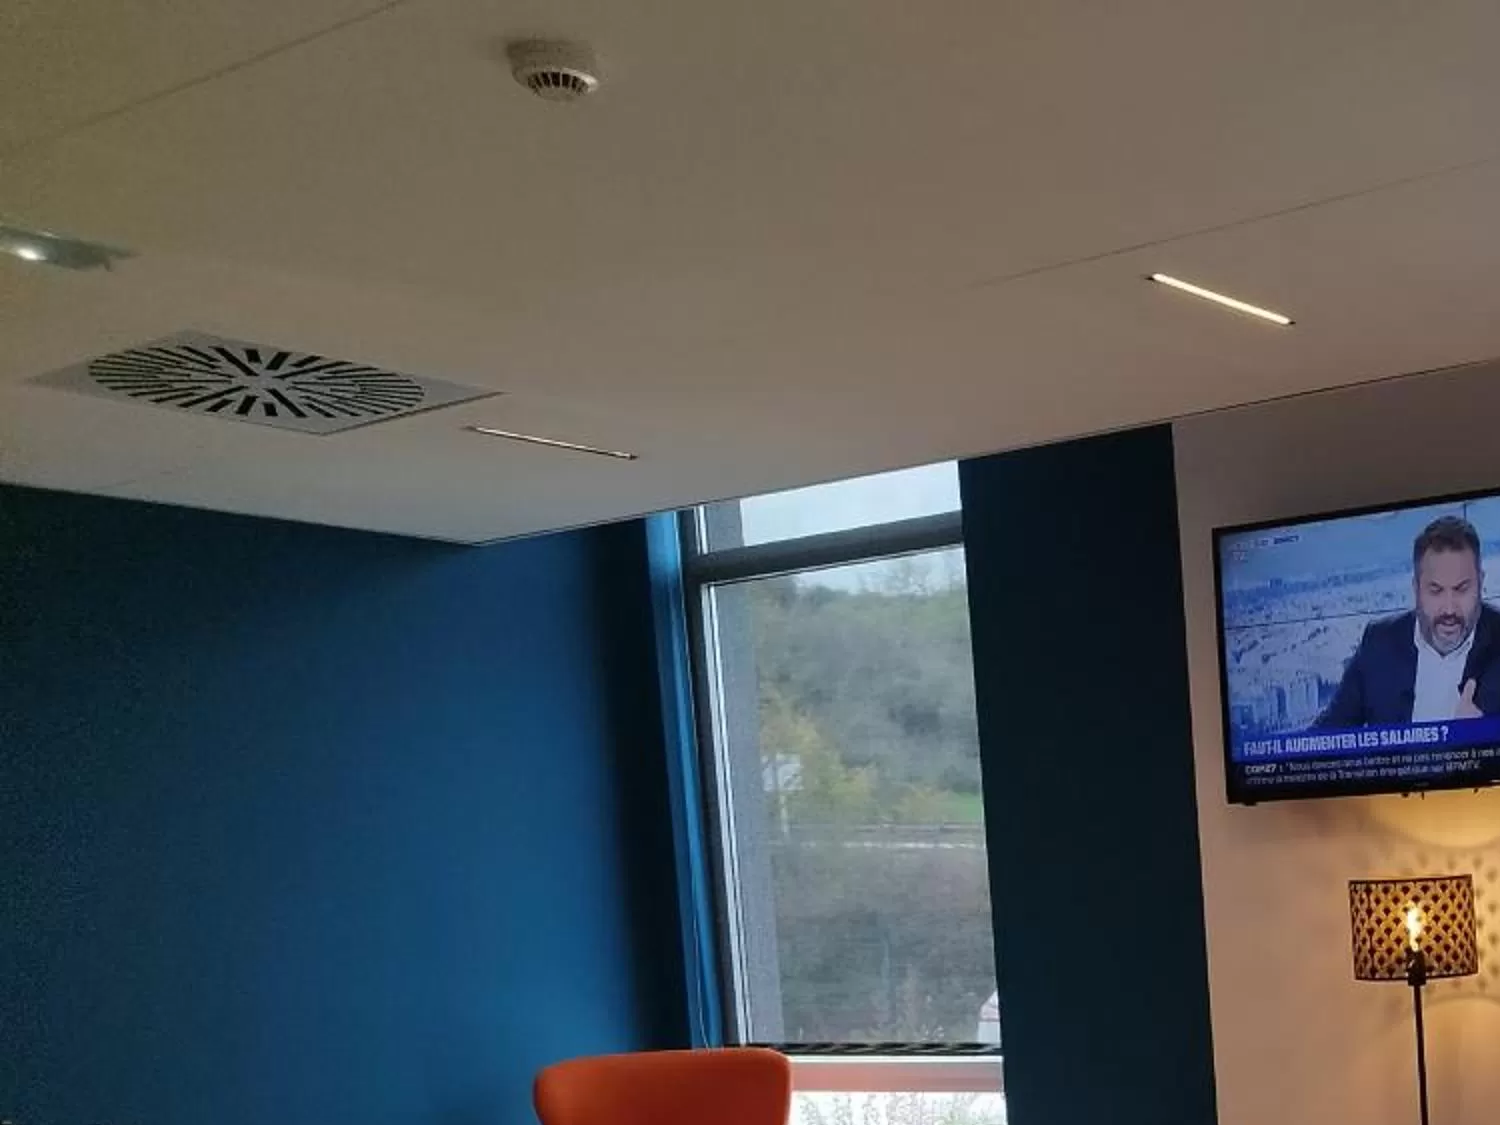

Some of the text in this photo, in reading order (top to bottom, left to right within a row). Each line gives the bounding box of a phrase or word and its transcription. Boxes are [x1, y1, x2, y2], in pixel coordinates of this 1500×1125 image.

[1243, 724, 1449, 757] FAUT-IL AUGMENTER LES SALAIRES ?
